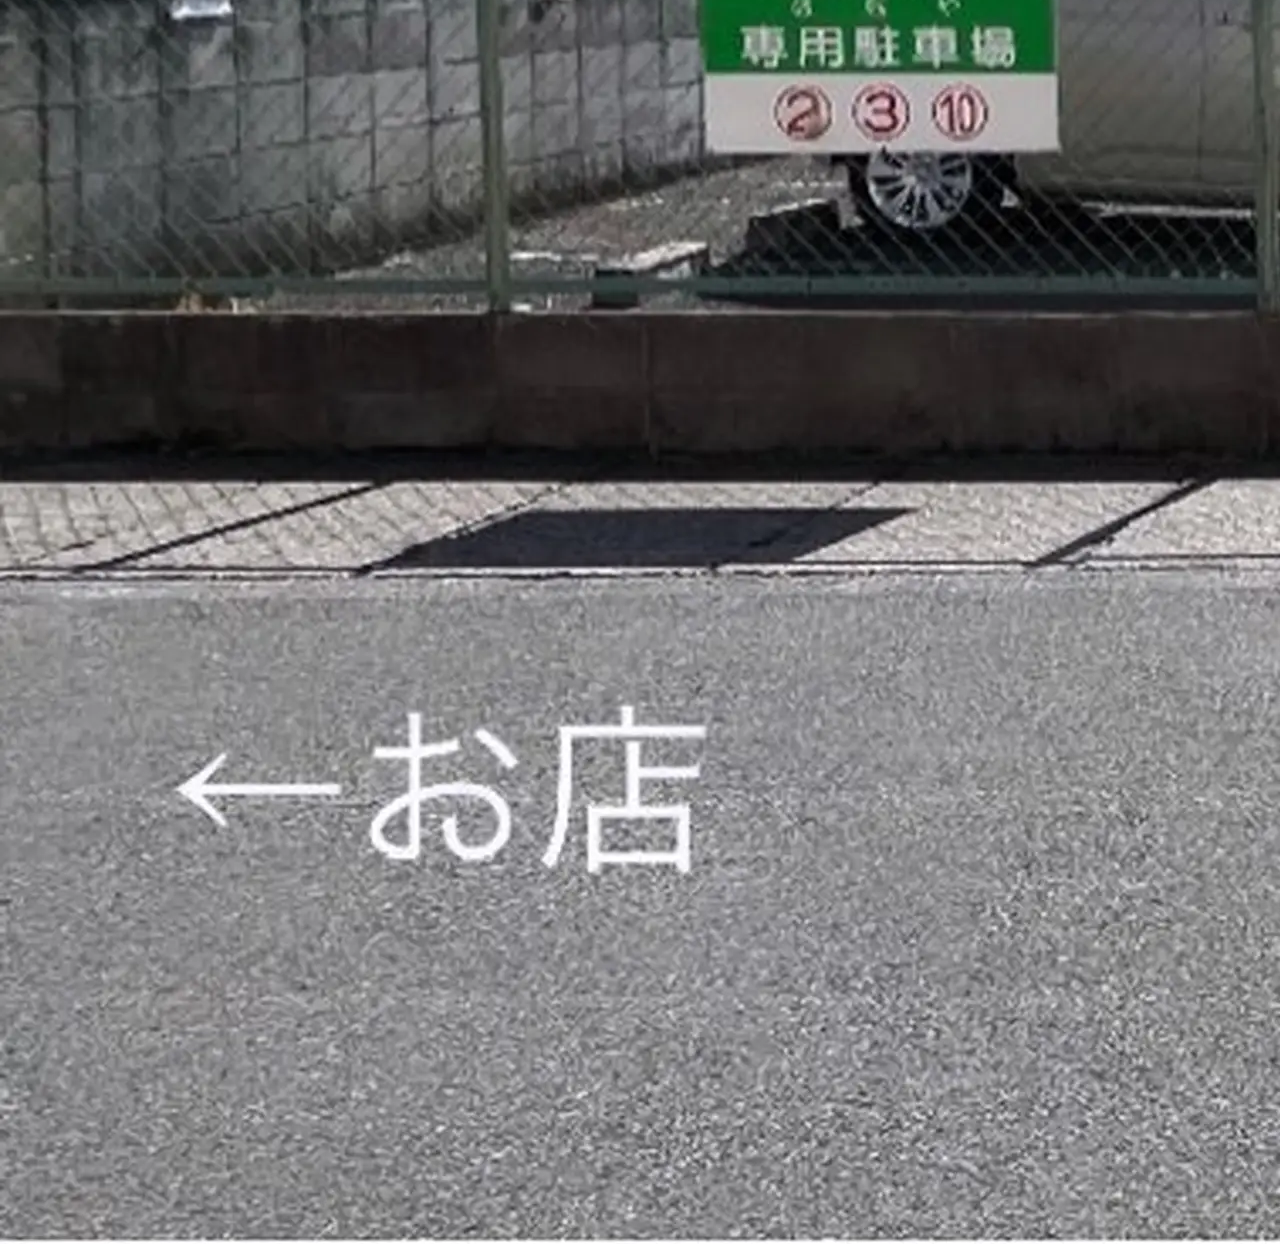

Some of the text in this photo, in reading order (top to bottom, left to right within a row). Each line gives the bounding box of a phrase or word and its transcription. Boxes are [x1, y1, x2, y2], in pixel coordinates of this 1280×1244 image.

[740, 24, 1017, 70] 専用駐車場
